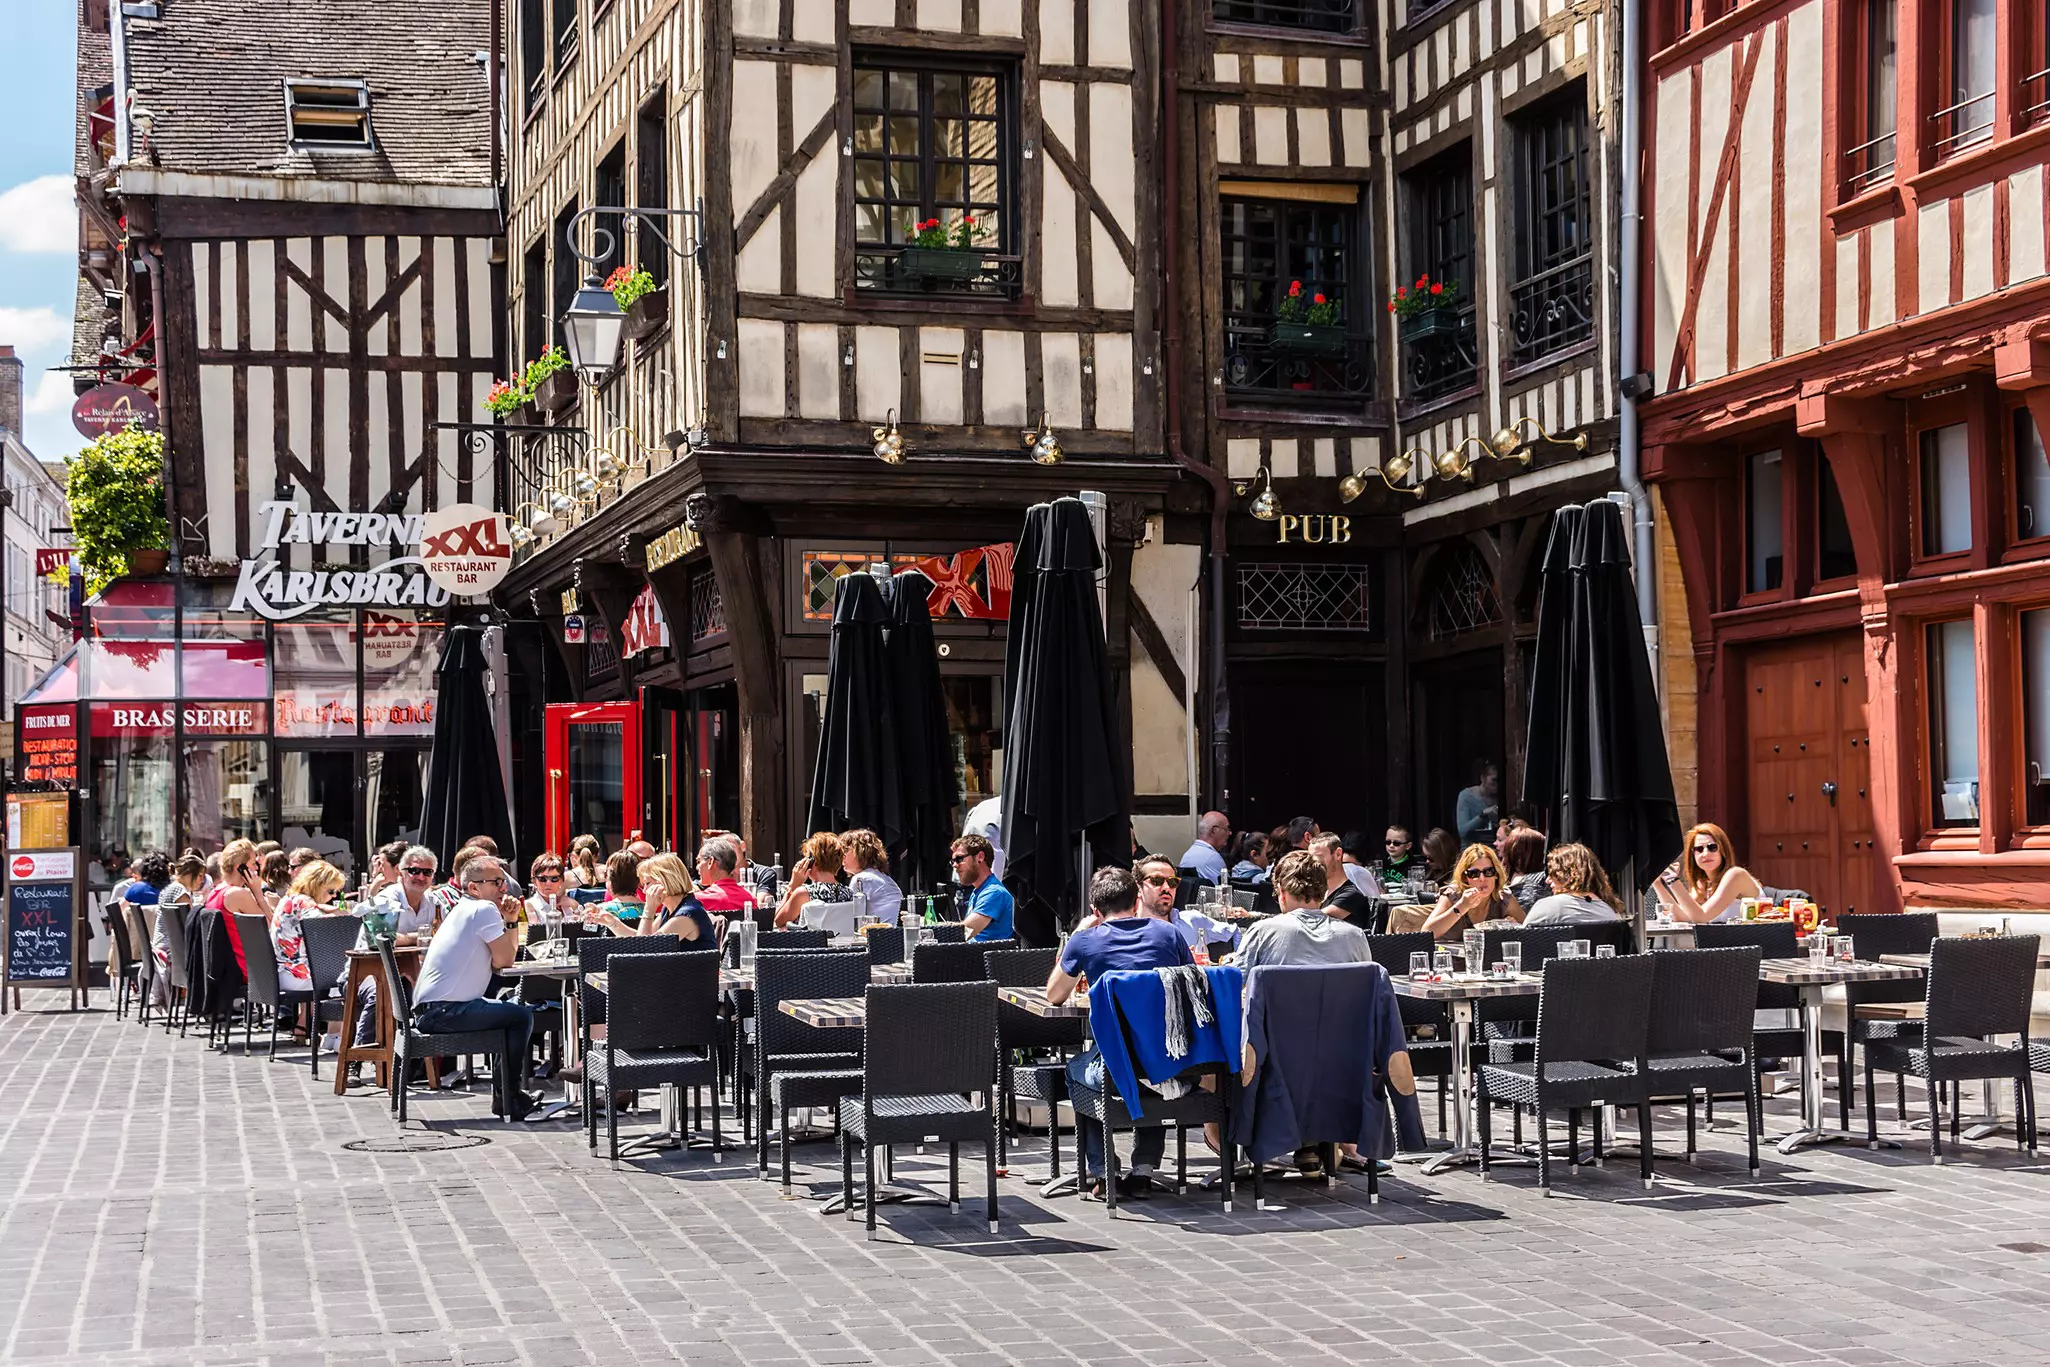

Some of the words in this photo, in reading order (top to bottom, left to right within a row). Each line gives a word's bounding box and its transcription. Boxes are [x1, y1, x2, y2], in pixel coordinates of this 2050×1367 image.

[92, 408, 114, 417] Relais
[1277, 515, 1351, 544] PUB
[423, 517, 511, 559] XXL
[645, 520, 702, 573] RESTAURANT
[431, 562, 497, 572] RESTAURANT
[457, 574, 477, 583] BAR
[25, 716, 46, 729] FRUITS
[47, 715, 56, 728] DE
[56, 714, 71, 727] MER
[15, 886, 69, 899] Restaurant
[22, 910, 58, 926] XXL
